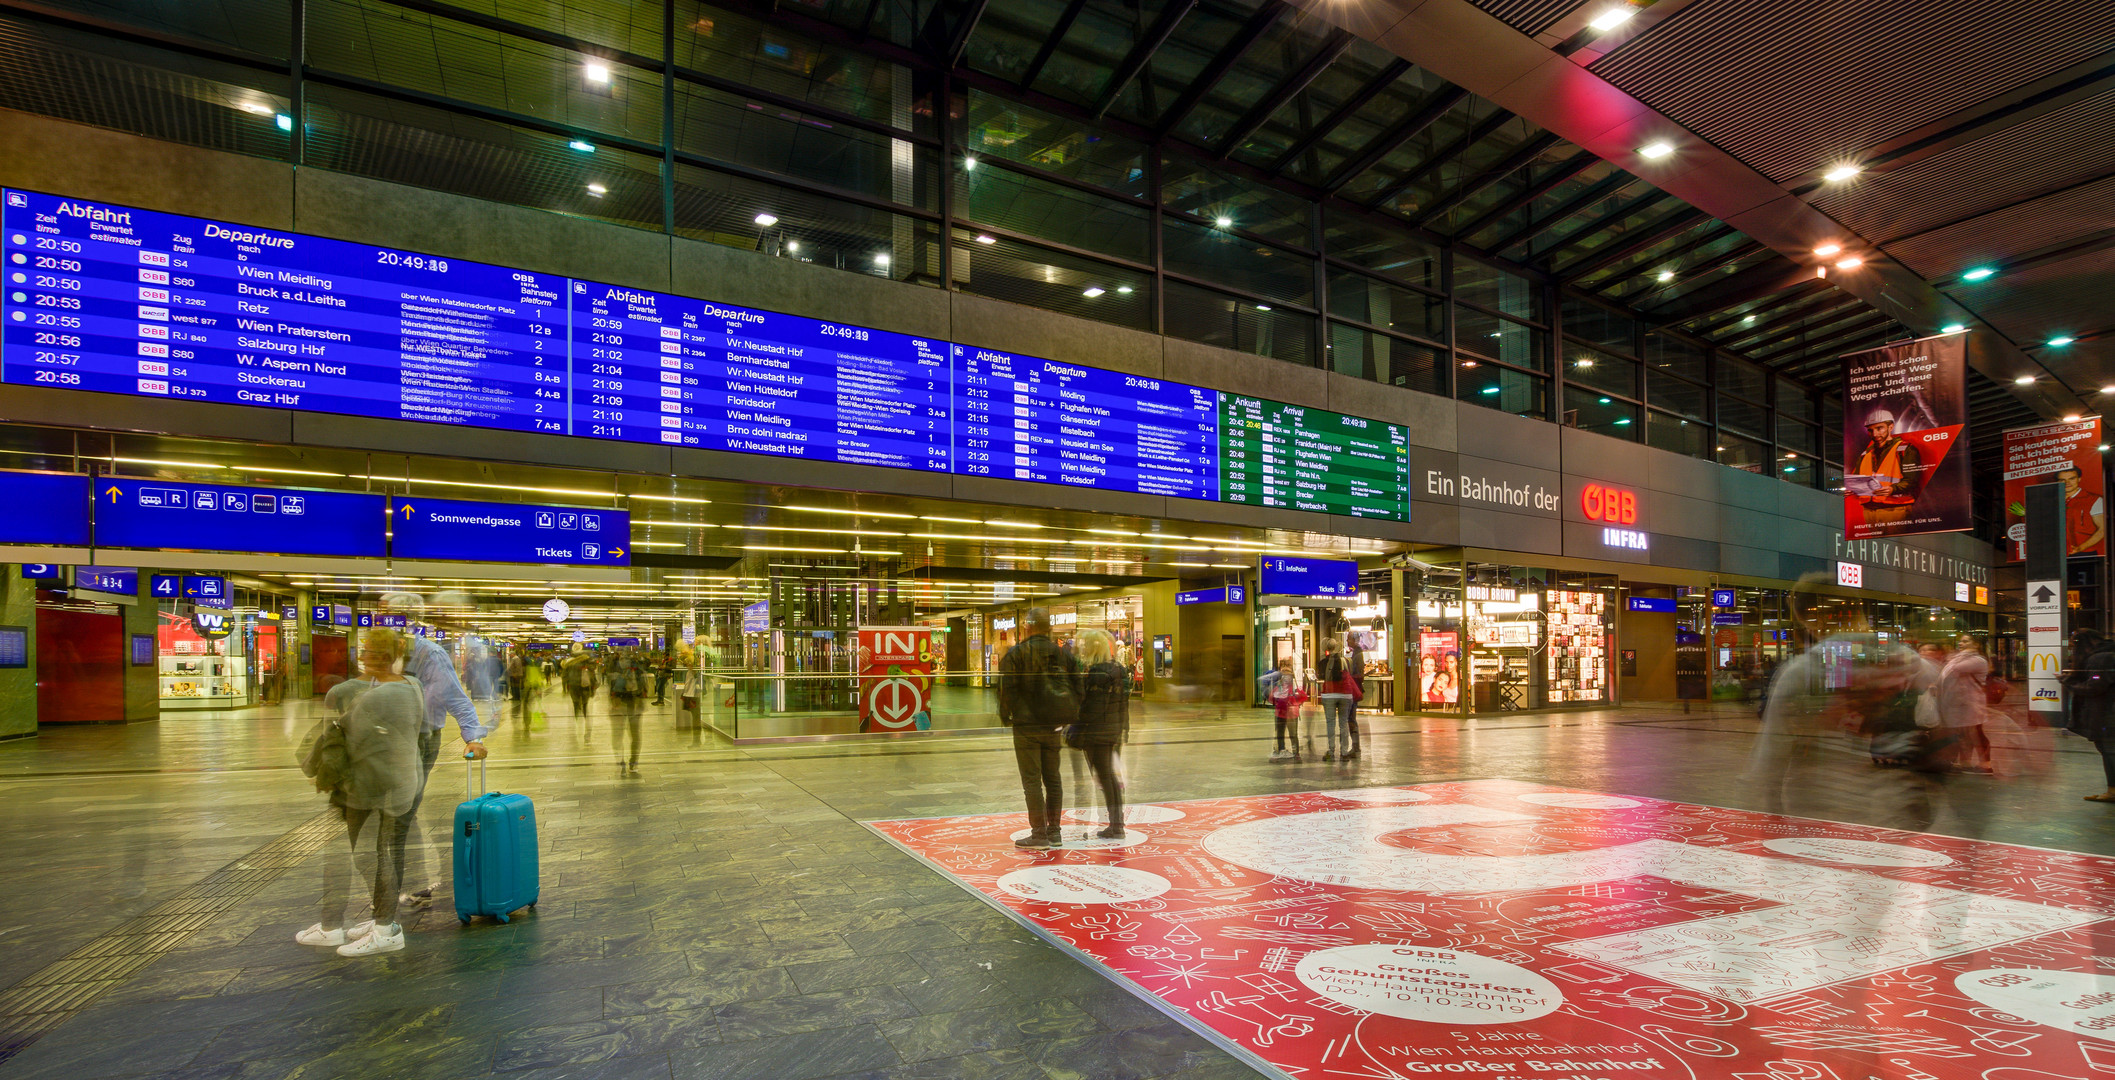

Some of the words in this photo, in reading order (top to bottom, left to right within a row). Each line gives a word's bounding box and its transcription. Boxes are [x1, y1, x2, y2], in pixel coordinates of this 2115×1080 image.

[35, 213, 57, 224] Zeit
[56, 201, 131, 225] Abfahrt
[35, 224, 61, 234] time
[90, 221, 133, 235] Erwartet
[89, 233, 142, 246] estimated
[172, 233, 192, 245] Zug
[204, 224, 295, 249] Departure
[35, 237, 81, 253] 20:50
[173, 244, 195, 254] train
[35, 256, 81, 272] 20:50
[173, 259, 188, 268] S4
[35, 275, 81, 291] 20:50
[172, 277, 195, 287] S60
[237, 265, 274, 280] Wien
[278, 271, 332, 290] Meidling
[238, 283, 279, 298] Bruck
[606, 288, 655, 306] Abfahrt
[35, 294, 81, 310] 20:53
[238, 300, 269, 314] Retz
[35, 313, 81, 328] 20:55
[172, 315, 199, 324] west
[704, 304, 765, 324] Departure
[236, 318, 273, 332] Wien
[278, 323, 351, 342] Praterstern
[529, 324, 543, 334] 12
[592, 317, 622, 330] 20:59
[35, 332, 81, 347] 20:56
[237, 336, 297, 355] Salzburg
[301, 343, 326, 356] Hbf
[592, 333, 623, 345] 21:00
[592, 348, 623, 361] 21:02
[726, 337, 785, 355] Wr.Neustadt
[787, 347, 803, 357] Hbf
[35, 351, 80, 366] 20:57
[236, 354, 257, 366] W.
[262, 357, 310, 371] Aspern
[315, 362, 346, 375] Nord
[727, 352, 790, 369] Bernhardsthal
[976, 351, 1011, 365] Abfahrt
[1850, 366, 1864, 376] Ich
[1866, 360, 1897, 372] wollte
[1899, 355, 1928, 366] schon
[592, 363, 622, 376] 21:04
[1044, 362, 1087, 378] Departure
[1850, 372, 1880, 384] immer
[1882, 368, 1906, 378] neue
[1909, 362, 1938, 374] Wege
[35, 370, 81, 385] 20:58
[237, 372, 306, 388] Stockerau
[535, 372, 543, 381] 8
[544, 375, 560, 383] A-B
[967, 375, 987, 385] 21:11
[1850, 382, 1882, 394] gehen.
[1885, 377, 1905, 387] Und
[1907, 373, 1932, 383] neue
[172, 386, 187, 395] RJ
[190, 389, 207, 397] 373
[726, 381, 751, 392] Wien
[754, 384, 798, 398] Hütteldorf
[967, 388, 988, 398] 21:12
[1060, 390, 1085, 402] Mödling
[1850, 391, 1878, 402] Wege
[1880, 383, 1924, 397] schaffen.
[237, 390, 271, 403] Graz
[275, 393, 300, 405] Hbf
[727, 395, 776, 409] Floridsdorf
[1235, 397, 1261, 409] Ankunft
[1060, 402, 1092, 413] Flughafen
[1093, 407, 1110, 416] Wien
[1283, 406, 1304, 417] Arrival
[727, 410, 752, 421] Wien
[754, 413, 791, 427] Meidling
[1229, 417, 1244, 427] 20:42
[727, 424, 750, 435] Brno
[751, 427, 773, 437] dolni
[775, 431, 807, 441] nadrazi
[1060, 426, 1095, 438] Mistelbach
[1229, 428, 1245, 437] 20:45
[1923, 432, 1949, 442] ÖBB
[1061, 438, 1089, 448] Neusiedl
[1101, 443, 1114, 452] See
[2009, 445, 2024, 454] Sie
[2024, 438, 2060, 450] kaufen
[2060, 432, 2092, 443] online
[2009, 453, 2027, 462] ein.
[2027, 450, 2042, 458] Ich
[2009, 460, 2037, 470] Ihnen
[2037, 455, 2066, 467] heim.
[2010, 462, 2070, 479] INTERSPAR.AT
[1427, 470, 1454, 497] Ein
[1460, 475, 1530, 509] Bahnhof
[1534, 488, 1559, 512] der
[171, 494, 181, 504] R
[1582, 483, 1637, 525] ÖBB
[430, 513, 521, 527] Sonnwendgasse
[1886, 519, 1914, 527] MORGEN.
[1604, 528, 1647, 550] INFRA
[535, 547, 572, 558] Tickets
[1286, 565, 1308, 573] InfoPoint
[1841, 565, 1858, 584] ÖBB
[110, 578, 122, 589] 3-4
[157, 579, 172, 594] 4
[1319, 585, 1335, 593] Tickets
[1466, 586, 1489, 600] BOBBI
[1491, 587, 1515, 601] BROWN
[316, 608, 325, 619] 5
[361, 617, 369, 625] 6
[875, 632, 915, 654] IN
[2035, 687, 2057, 697] dm
[1392, 948, 1457, 961] ÖBB
[1377, 963, 1471, 980] Großes
[1318, 966, 1536, 996] Geburtstagsfest
[1307, 972, 1364, 986] Wien
[1373, 980, 1548, 1008] Hauptbahnhof
[1325, 984, 1371, 998] Do.,
[1384, 991, 1525, 1014] 10.10.2019
[1776, 1019, 1932, 1035] infrastruktur.oebb.at
[1450, 1031, 1470, 1042] 5
[1480, 1030, 1544, 1042] Jahre
[1379, 1045, 1453, 1057] Wien
[1456, 1042, 1650, 1058] Hauptbahnhof
[1405, 1059, 1523, 1073] Großer
[1524, 1057, 1666, 1072] Bahnhof
